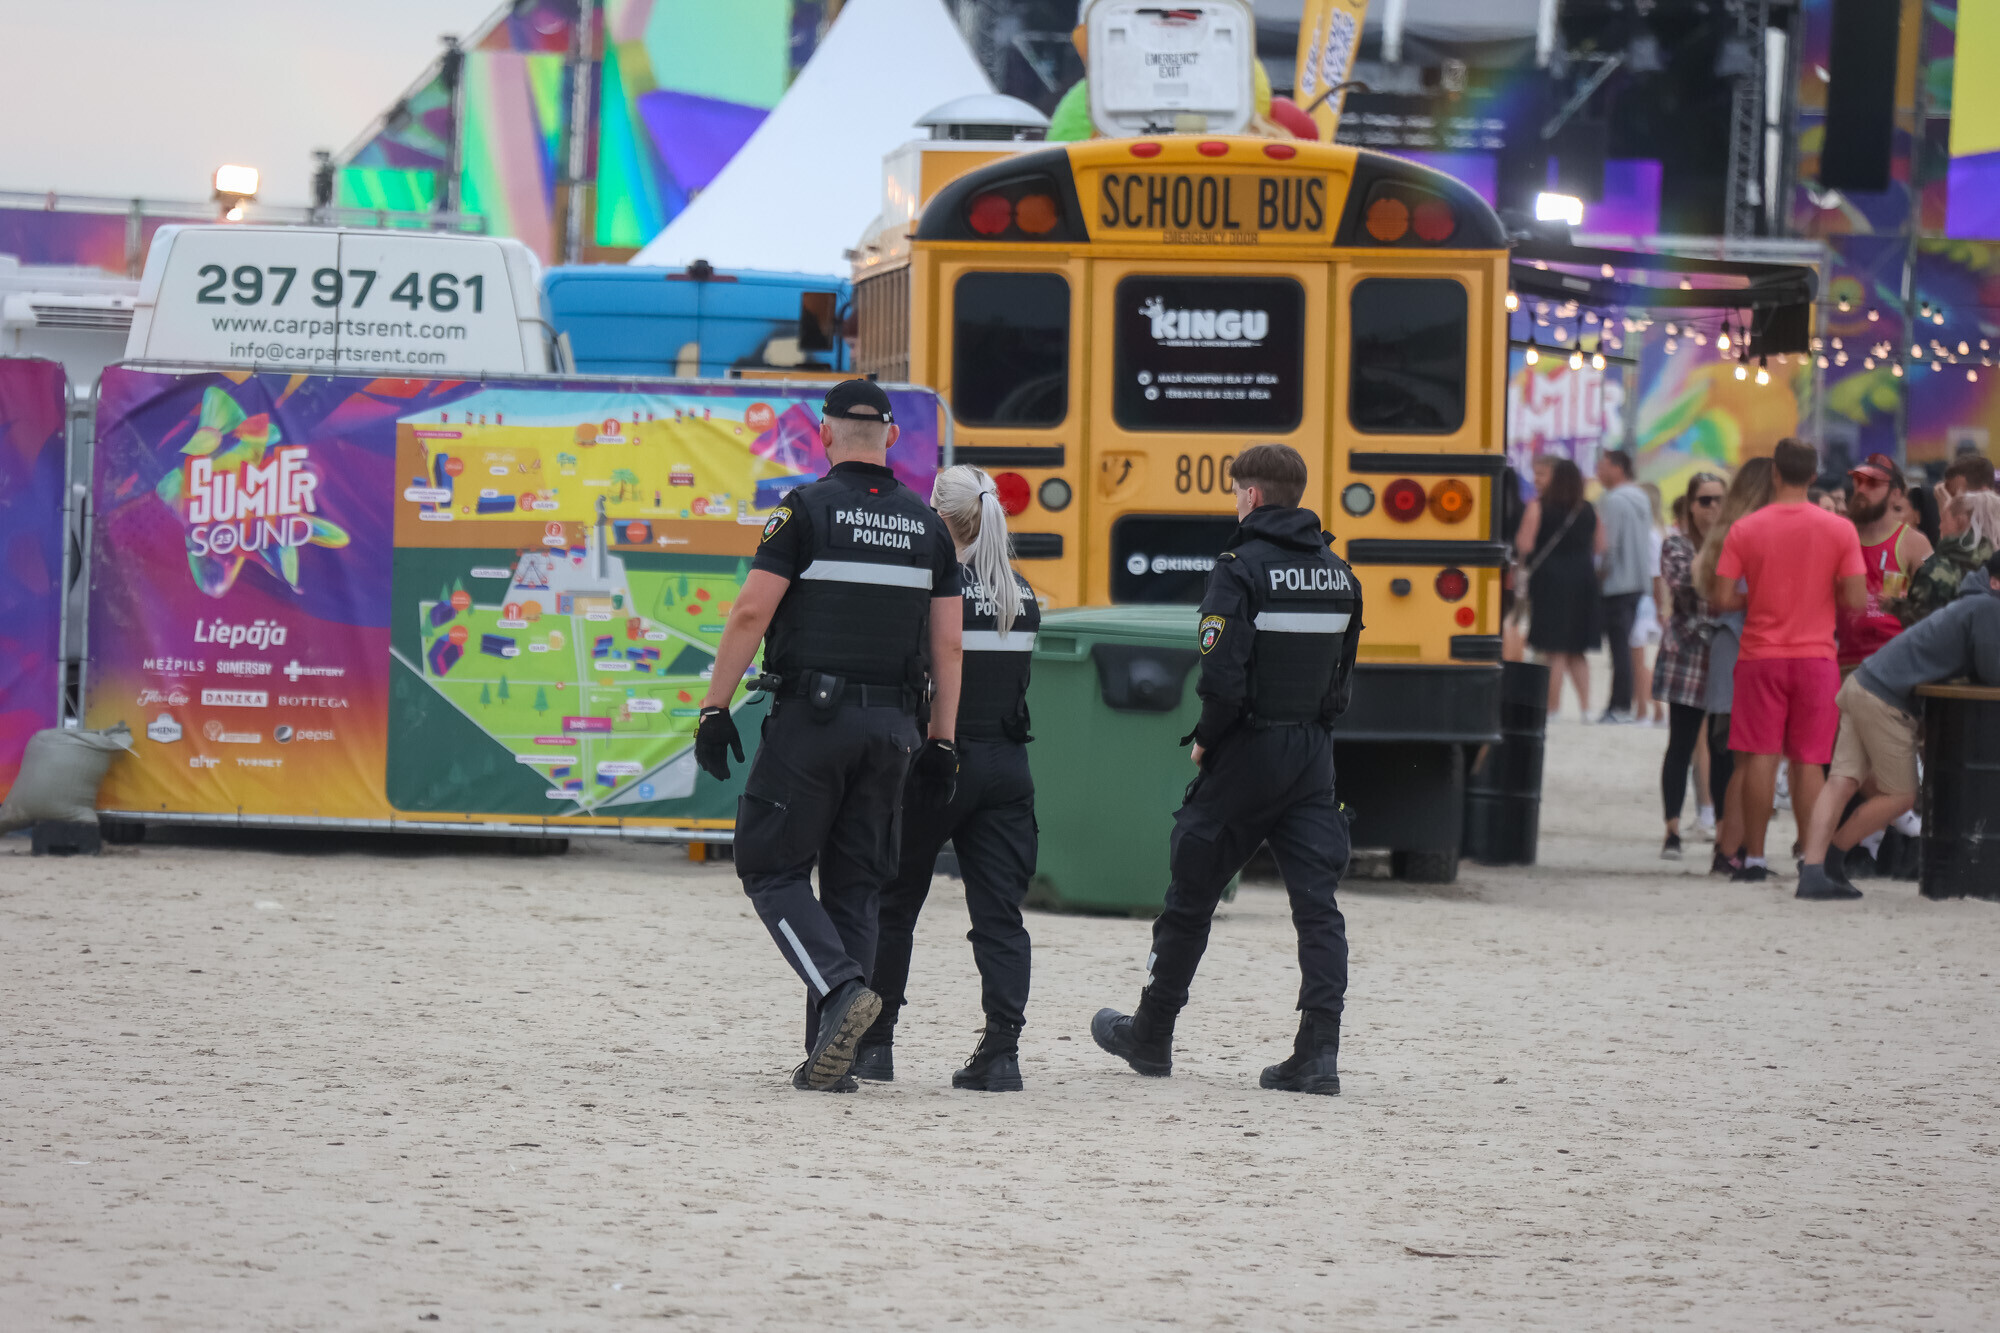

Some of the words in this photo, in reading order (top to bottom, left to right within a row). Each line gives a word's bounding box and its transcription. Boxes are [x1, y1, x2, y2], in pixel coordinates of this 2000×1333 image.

[1145, 52, 1199, 66] EMERGENCY
[1159, 66, 1181, 78] EXIT
[1101, 173, 1240, 230] SCHOOL
[1258, 178, 1324, 232] BUS
[196, 264, 297, 306] 297
[311, 267, 377, 309] 97
[389, 271, 485, 314] 461
[212, 316, 466, 340] www.carpartsrent.com
[1151, 308, 1269, 341] KINGU
[229, 342, 446, 365] info@carpartsrent.com
[835, 507, 926, 536] PAŠVALDĪBAS
[191, 516, 314, 557] SOUND
[852, 528, 912, 550] POLICIJA
[1269, 568, 1351, 592] POLICIJA
[194, 618, 288, 650] Liepāja
[143, 657, 206, 672] MEŽPILS
[216, 660, 272, 676] SOMERSBY
[204, 692, 262, 705] DANZKA
[278, 696, 349, 708] BOTTEGA
[296, 729, 333, 742] pepsi
